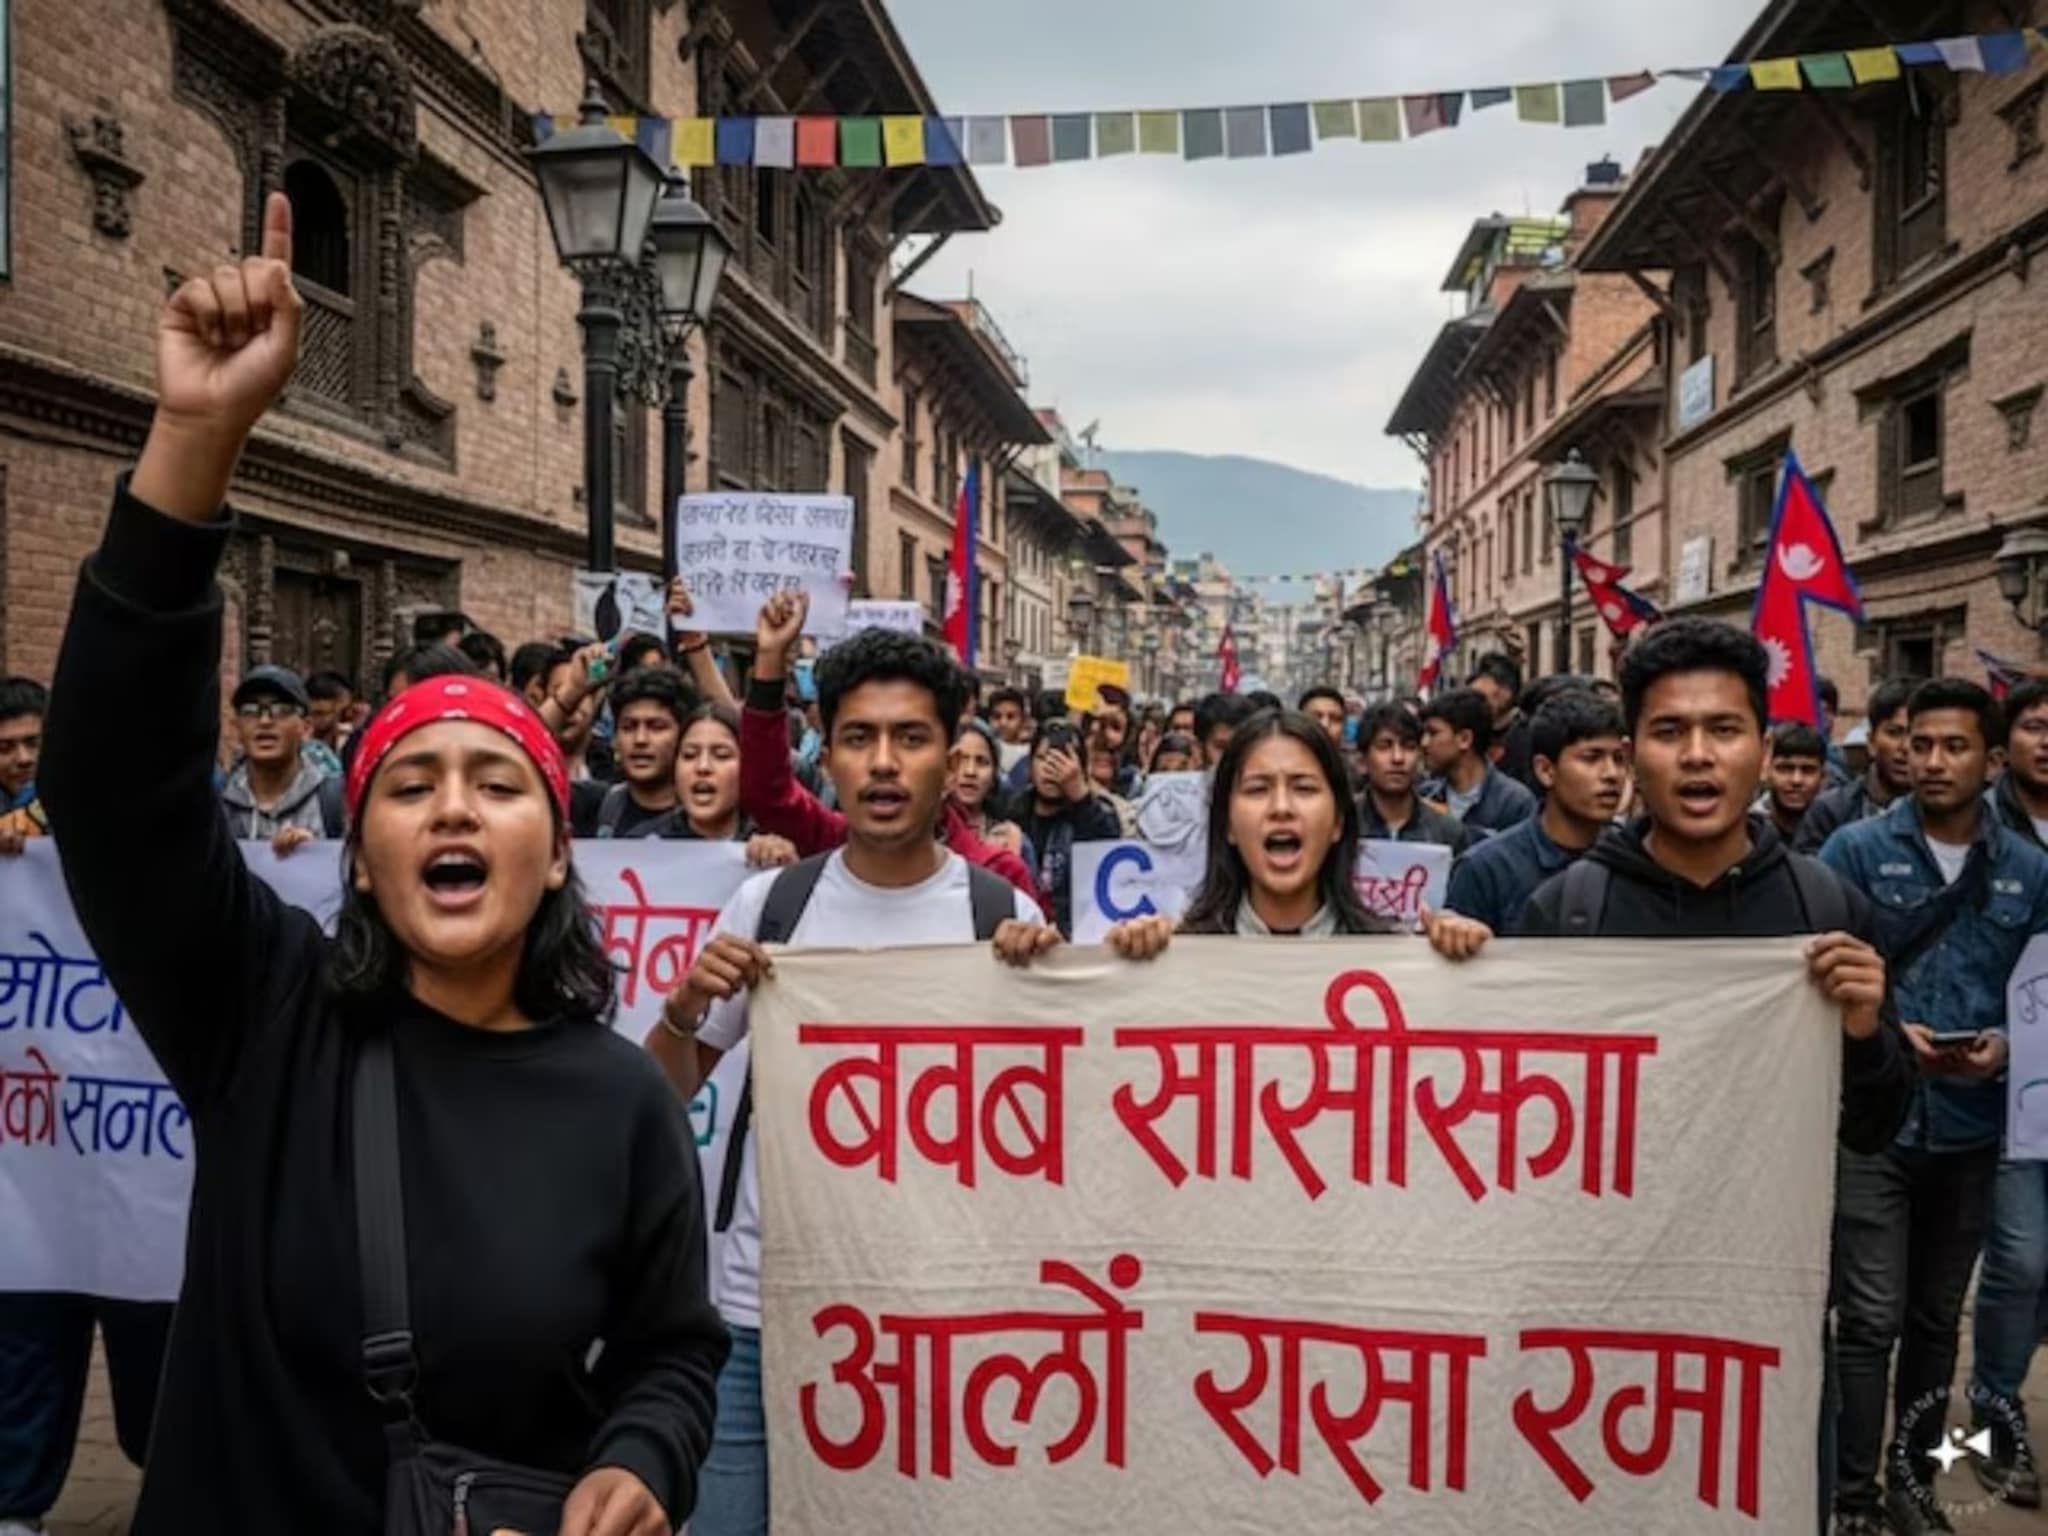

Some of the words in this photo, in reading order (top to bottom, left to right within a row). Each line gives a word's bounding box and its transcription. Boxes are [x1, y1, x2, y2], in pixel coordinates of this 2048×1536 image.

[1094, 845, 1157, 921] C
[797, 1024, 1083, 1189] बवब
[799, 1253, 1143, 1480] आलों
[1193, 1312, 1487, 1505] रासा
[1512, 1328, 1780, 1519] रमा
